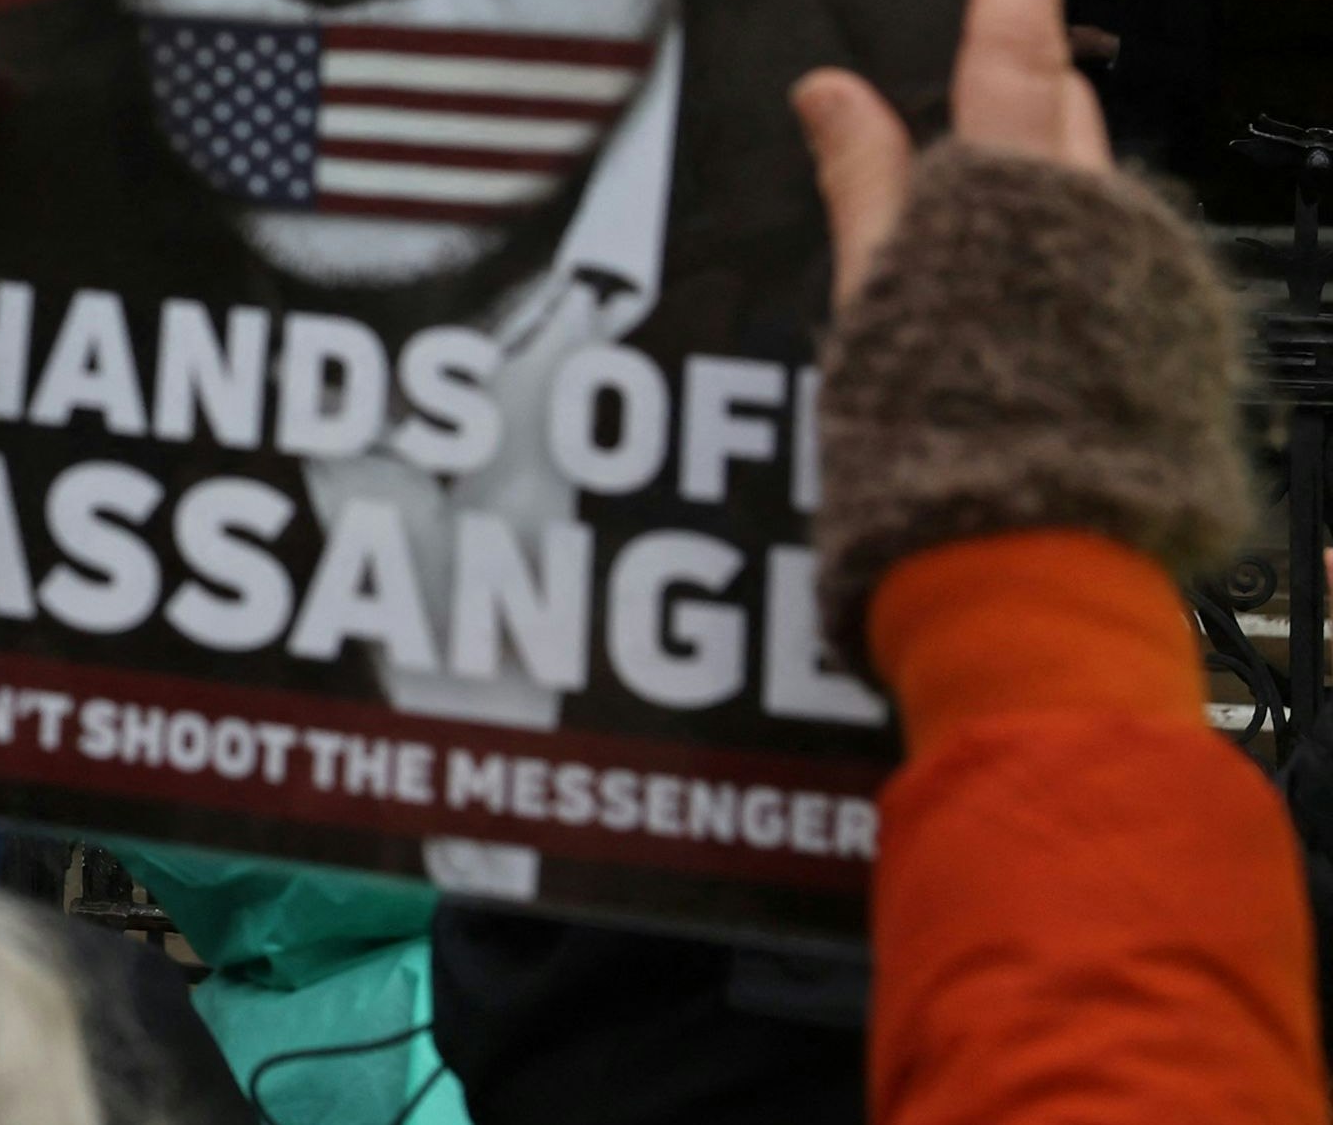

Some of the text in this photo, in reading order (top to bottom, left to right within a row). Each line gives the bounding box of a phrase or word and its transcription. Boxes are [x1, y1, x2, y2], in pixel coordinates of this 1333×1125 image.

[77, 697, 295, 785] SHOOT
[304, 727, 436, 804] THE
[445, 747, 880, 860] MESSENGER
